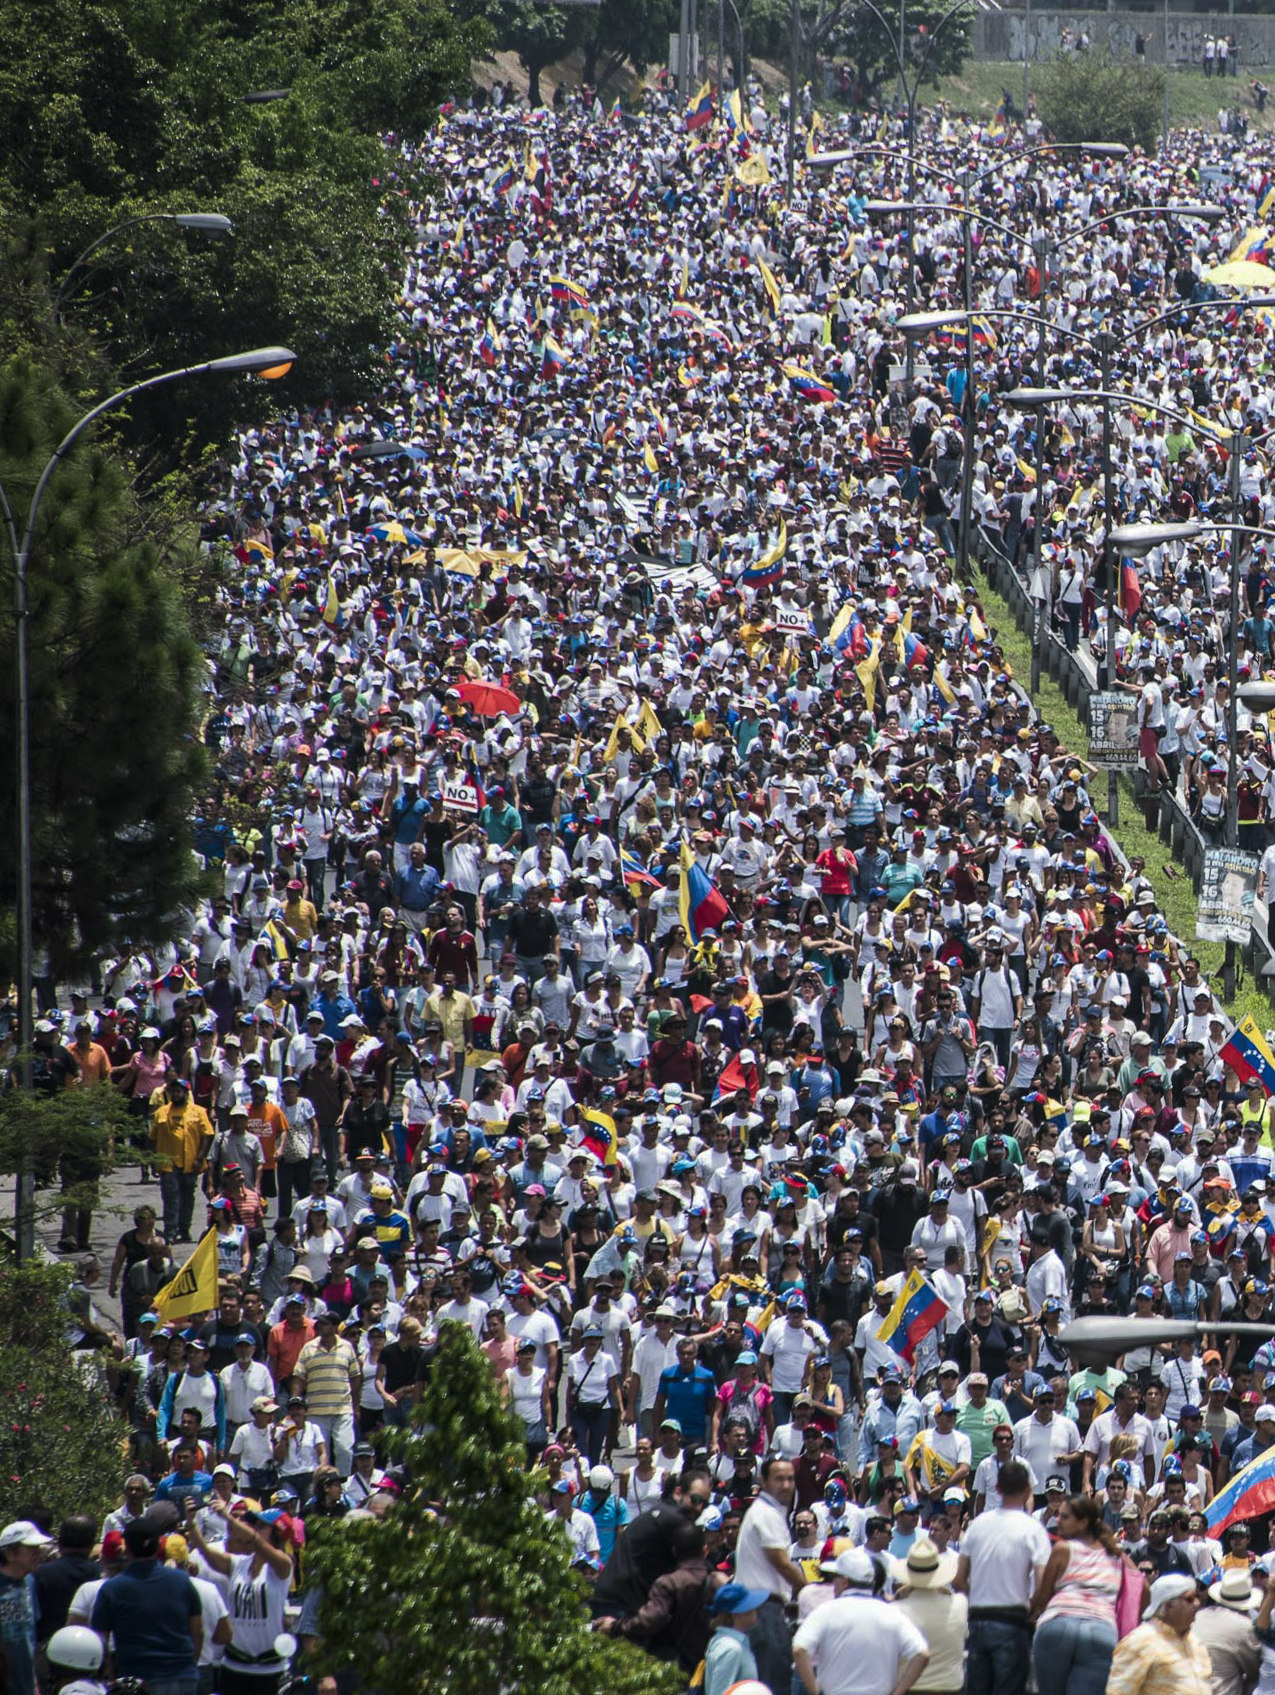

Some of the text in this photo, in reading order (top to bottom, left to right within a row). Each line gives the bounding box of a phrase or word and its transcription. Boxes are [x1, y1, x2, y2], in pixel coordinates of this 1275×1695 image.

[779, 613, 805, 625] NO+
[1090, 710, 1104, 722] 15
[1090, 726, 1105, 738] 16
[1090, 741, 1116, 749] ABRIL
[447, 787, 477, 801] NO+
[1205, 850, 1259, 868] MALANDRO
[1203, 867, 1219, 881] 15
[1201, 885, 1218, 897] 16
